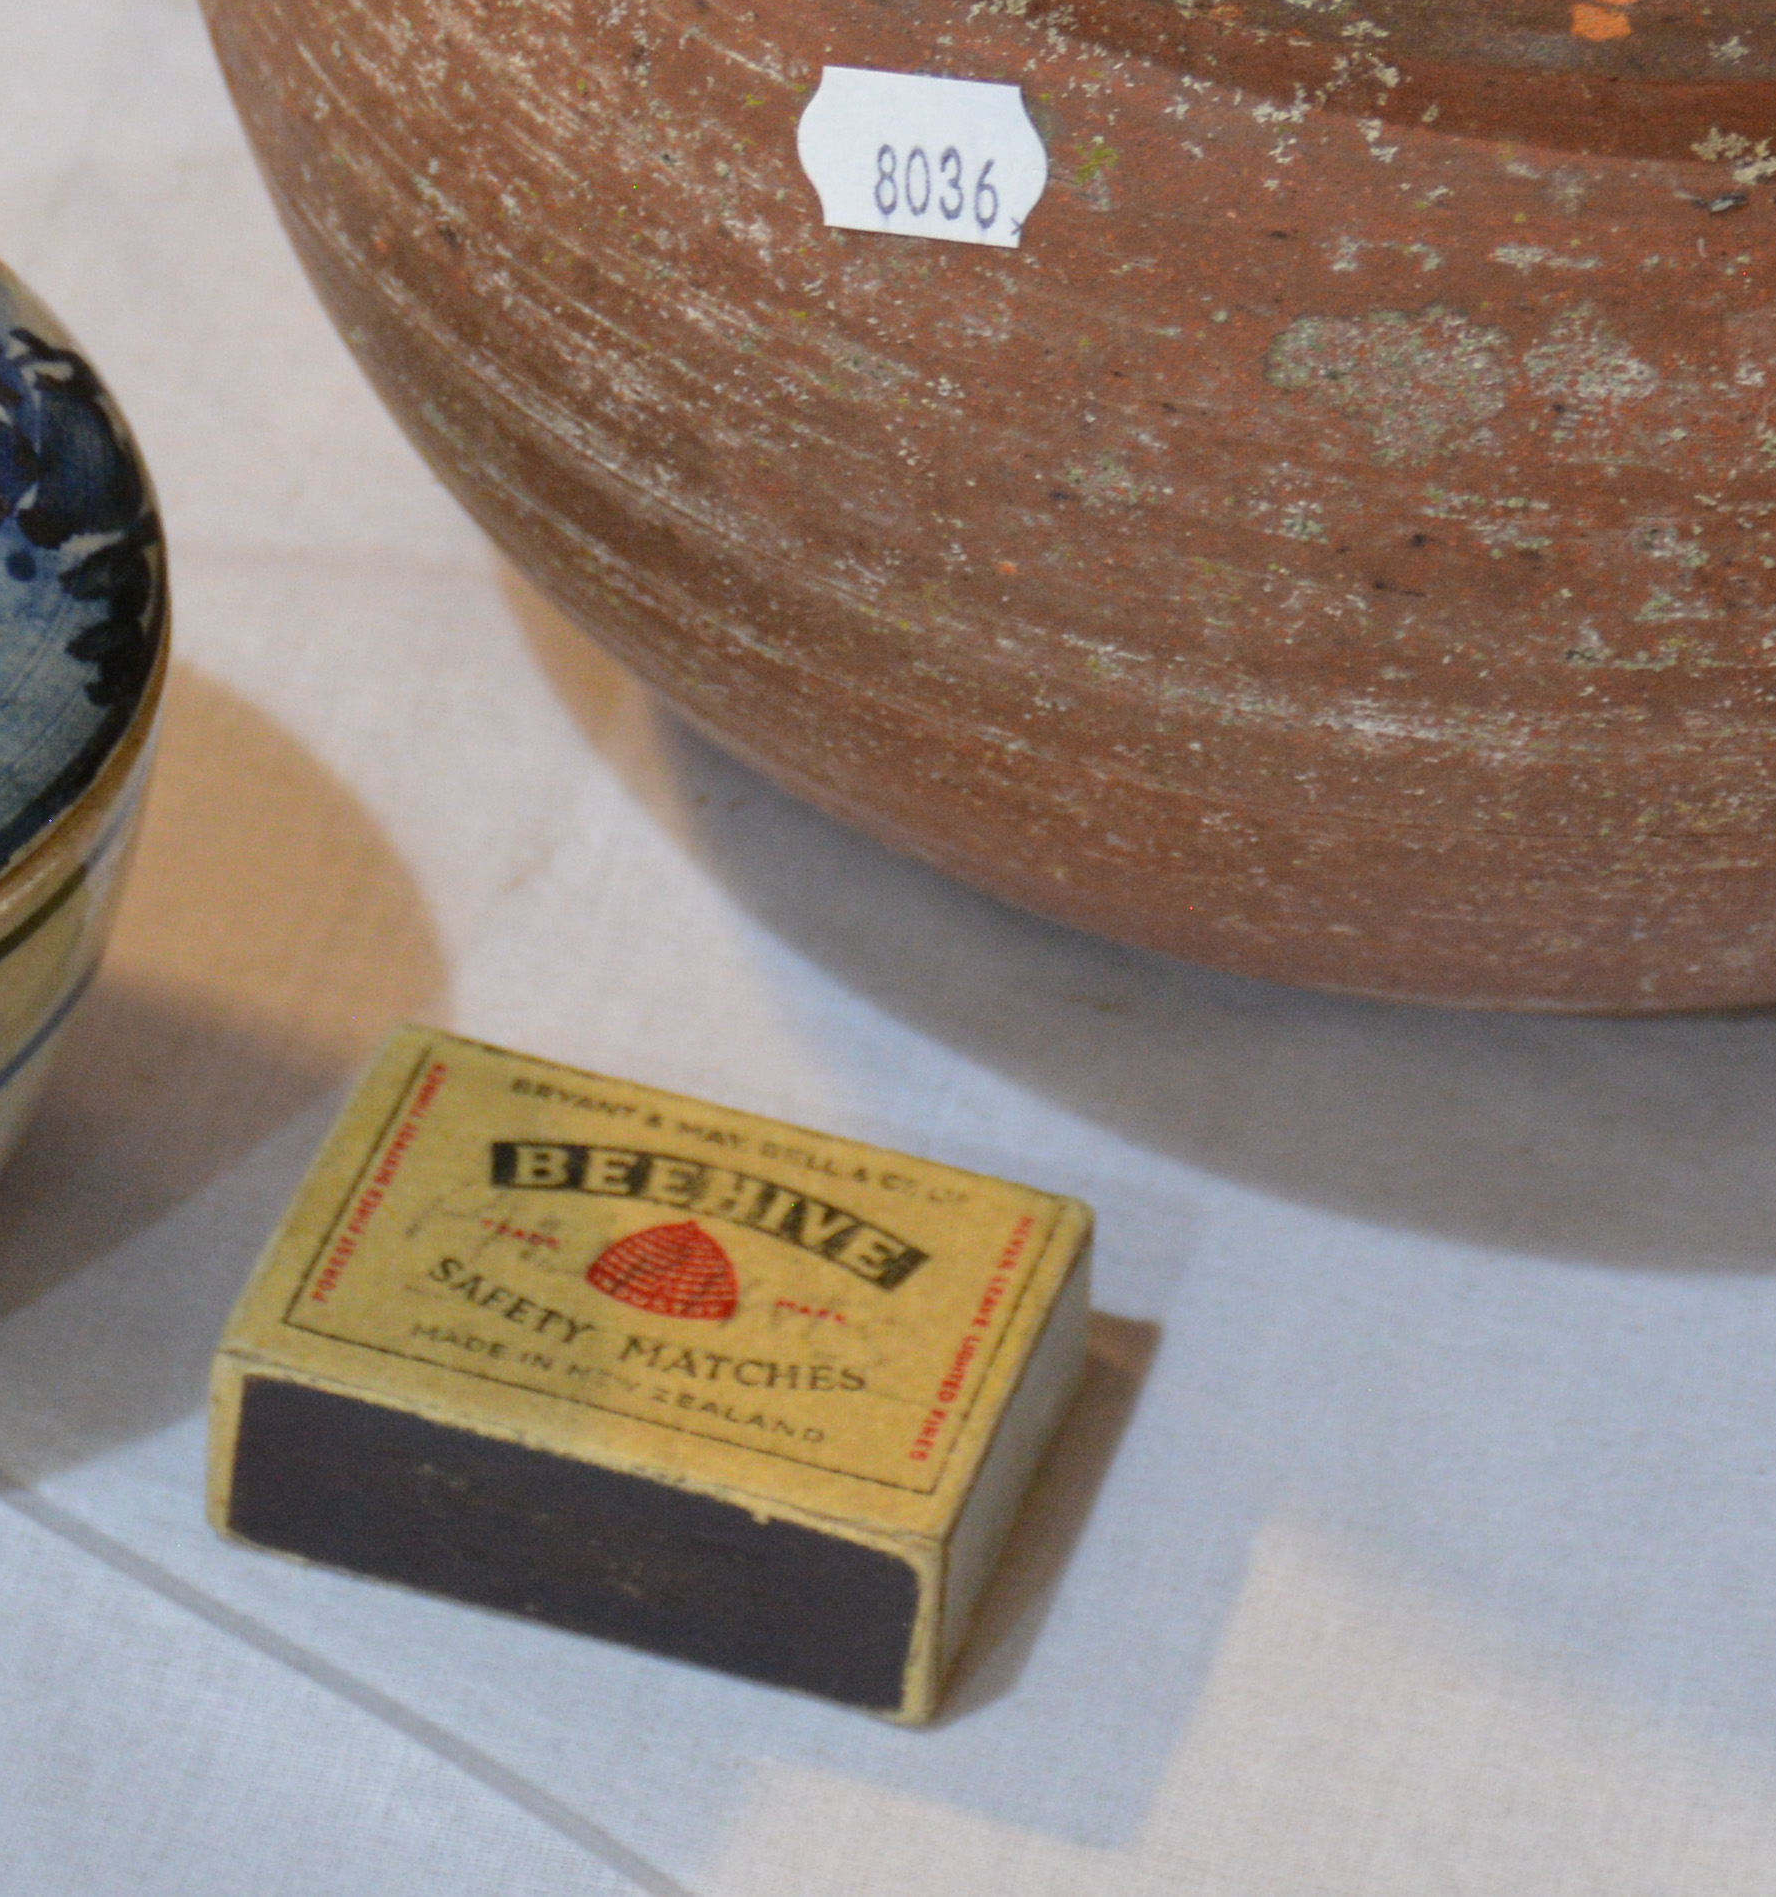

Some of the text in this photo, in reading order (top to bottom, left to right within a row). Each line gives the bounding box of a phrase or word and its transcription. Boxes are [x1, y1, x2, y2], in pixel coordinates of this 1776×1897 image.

[874, 143, 998, 229] 8036
[510, 1078, 638, 1116] BRYANT
[311, 1234, 357, 1304] FOREST
[505, 1142, 913, 1288] BEEHIVE
[411, 1323, 508, 1359] MADE
[519, 1351, 554, 1371] IN
[649, 1386, 826, 1445] ZEALAND
[428, 1256, 868, 1392] SAFETY MATCHES
[907, 1214, 1035, 1463] NEVER LEAVE LIGHTED FIRES
